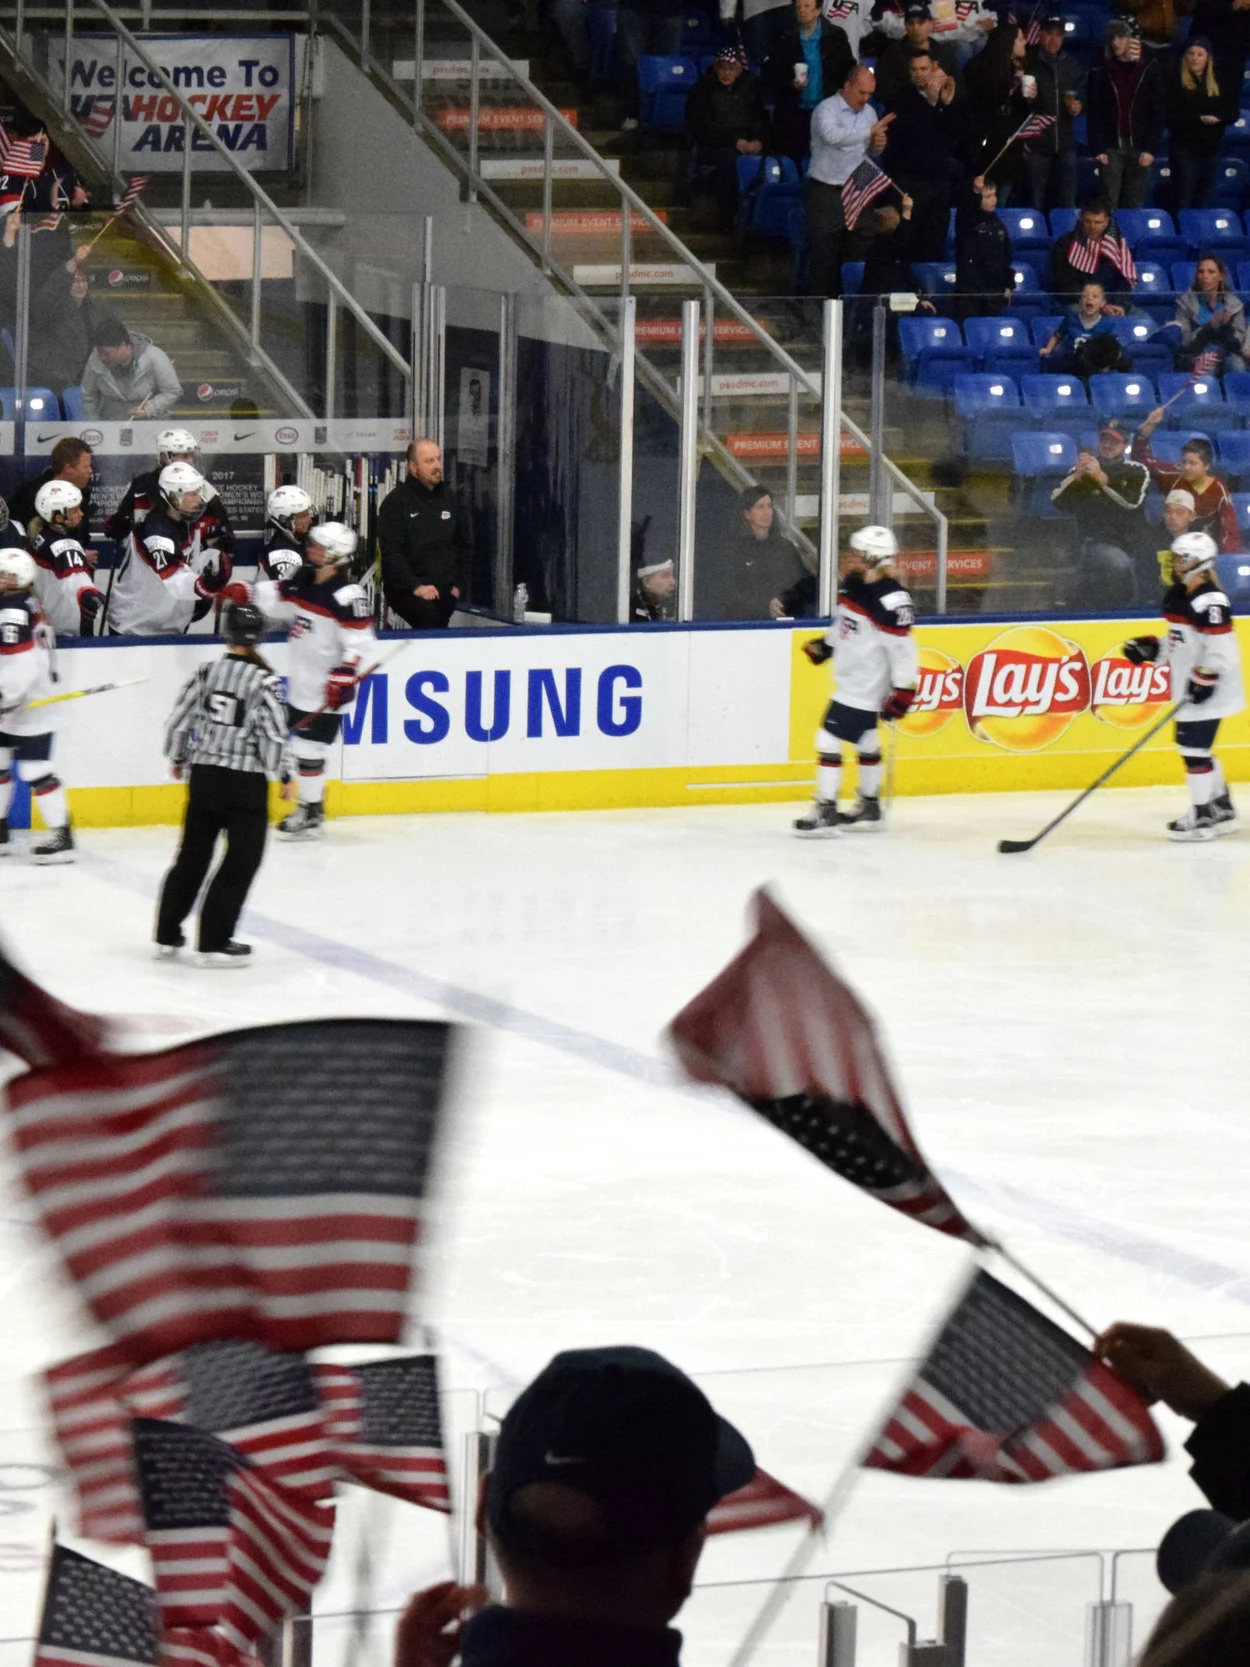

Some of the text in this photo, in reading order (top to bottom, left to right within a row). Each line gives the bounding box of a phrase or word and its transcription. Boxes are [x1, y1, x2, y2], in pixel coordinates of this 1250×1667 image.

[58, 59, 280, 88] Welcome To
[132, 124, 268, 152] ARENA
[635, 326, 676, 335] REMIUM
[734, 440, 782, 450] PREMIUM
[212, 471, 235, 481] 2017
[226, 484, 258, 492] HOCKEY
[65, 550, 84, 568] 14
[153, 550, 168, 571] 21
[947, 558, 982, 569] RVICES
[972, 654, 1083, 717] Lay's
[1093, 660, 1171, 705] Lay's
[343, 664, 643, 745] MSUNG
